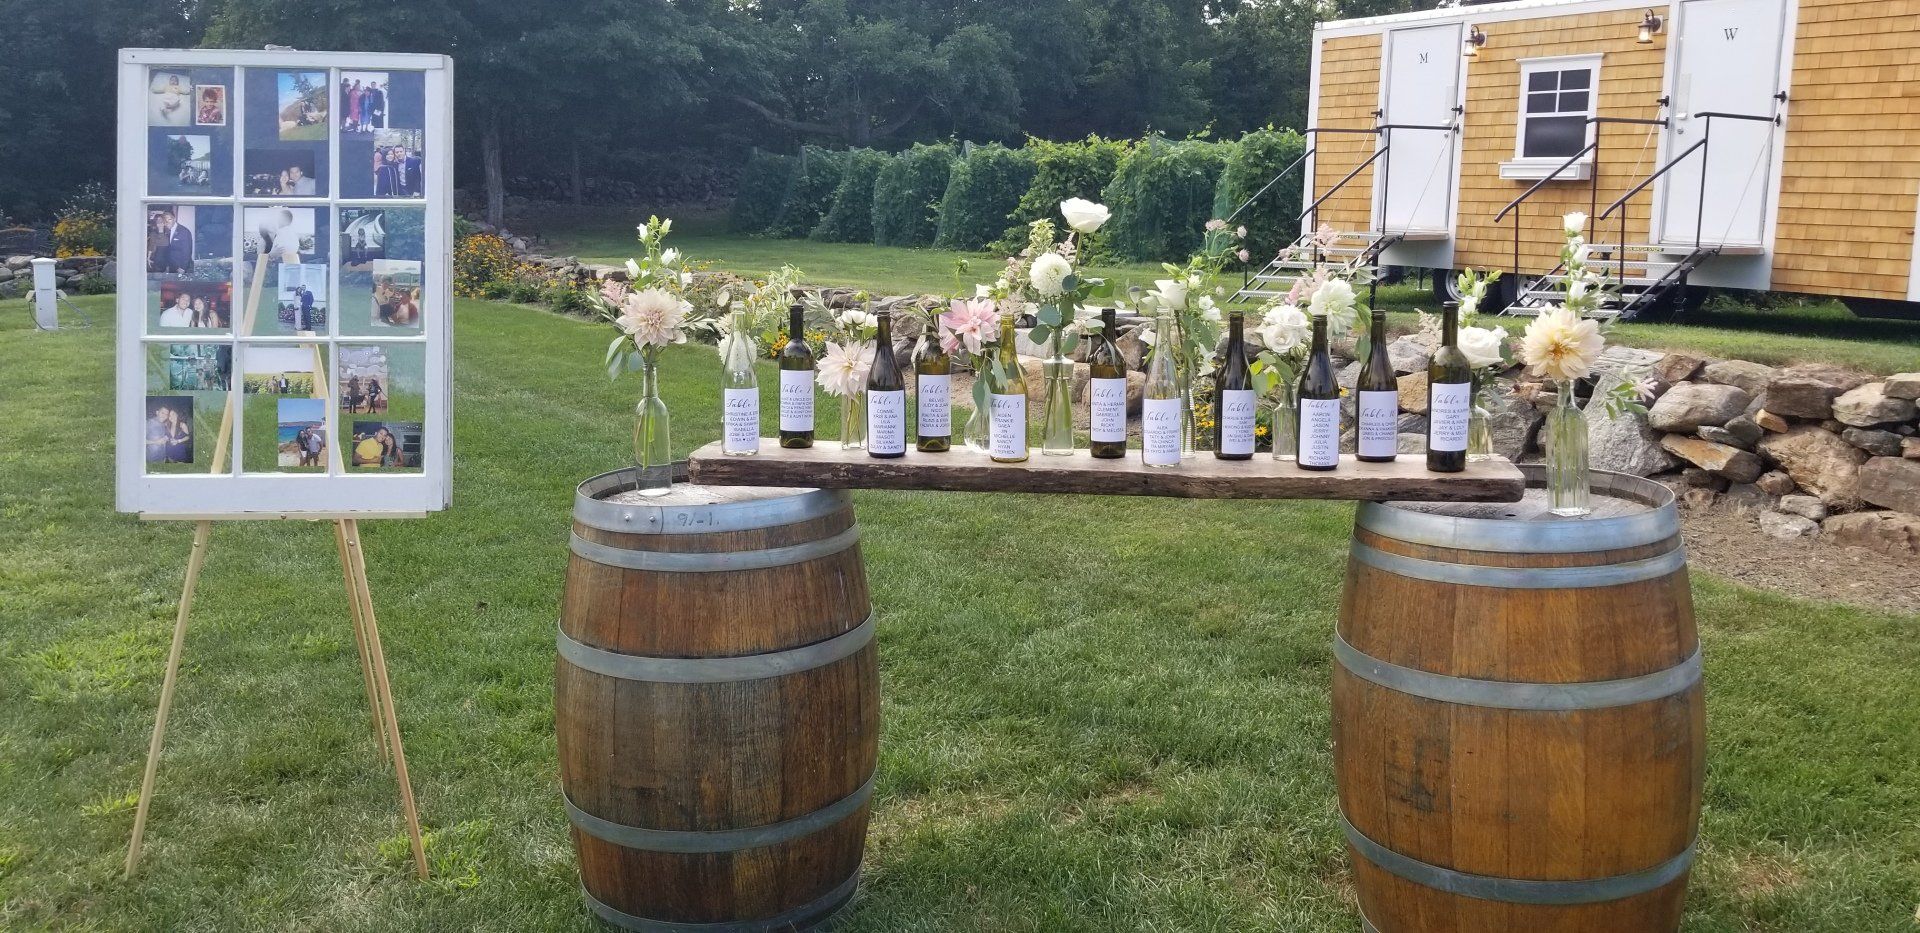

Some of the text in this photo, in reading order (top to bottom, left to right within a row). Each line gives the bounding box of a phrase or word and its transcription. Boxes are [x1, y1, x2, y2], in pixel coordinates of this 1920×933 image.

[1724, 26, 1738, 40] W
[1419, 51, 1428, 64] M
[920, 384, 943, 394] Table
[1092, 388, 1114, 398] Table
[726, 398, 751, 408] Table
[870, 394, 892, 406] Table
[990, 398, 1010, 408] Table
[1306, 400, 1327, 408] Table
[1434, 394, 1459, 404] Table
[1227, 402, 1249, 412] Table
[1146, 411, 1168, 422] Table
[1360, 408, 1384, 418] Table
